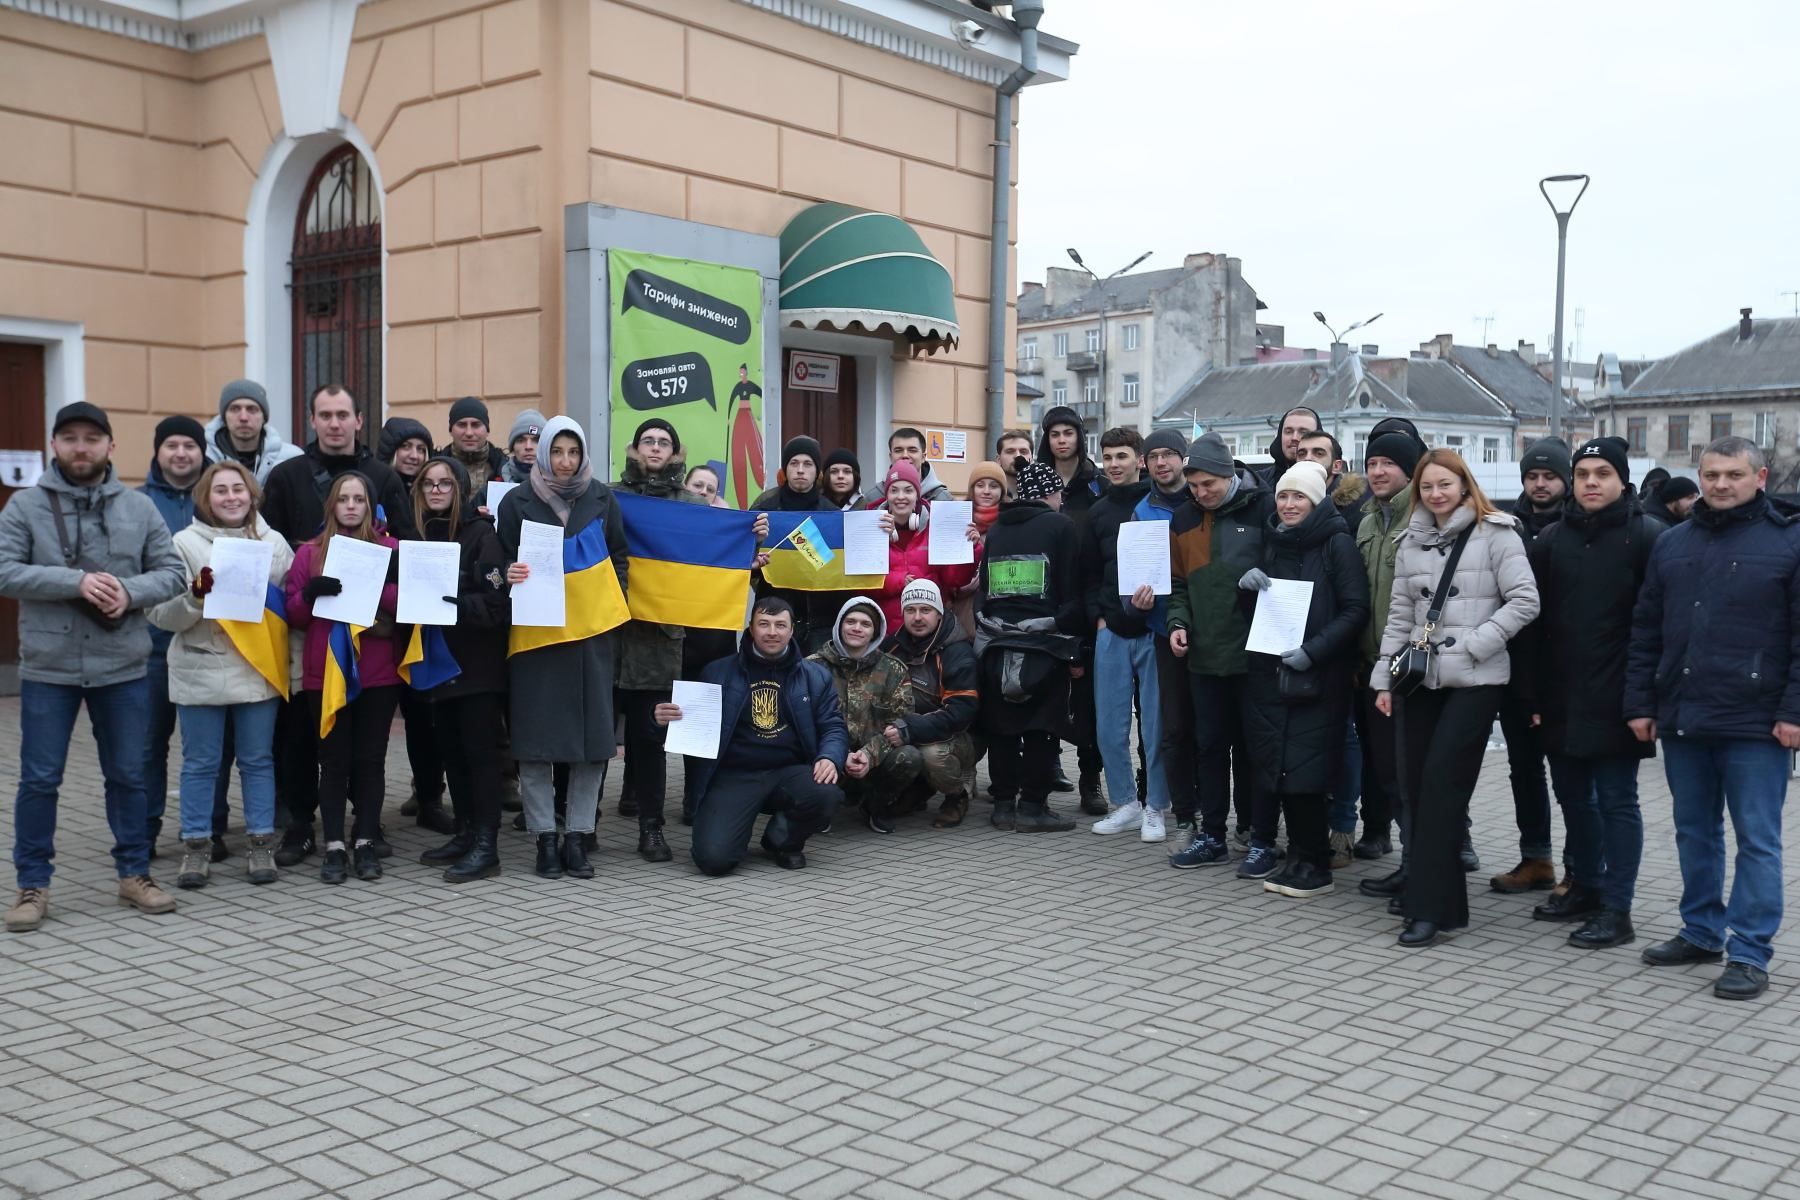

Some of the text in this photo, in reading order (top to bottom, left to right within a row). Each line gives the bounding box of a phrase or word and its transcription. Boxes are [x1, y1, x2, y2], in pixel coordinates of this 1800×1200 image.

[643, 283, 738, 328] Тарифи знижено!
[637, 363, 696, 378] Замовляй авто
[660, 376, 688, 397] 579
